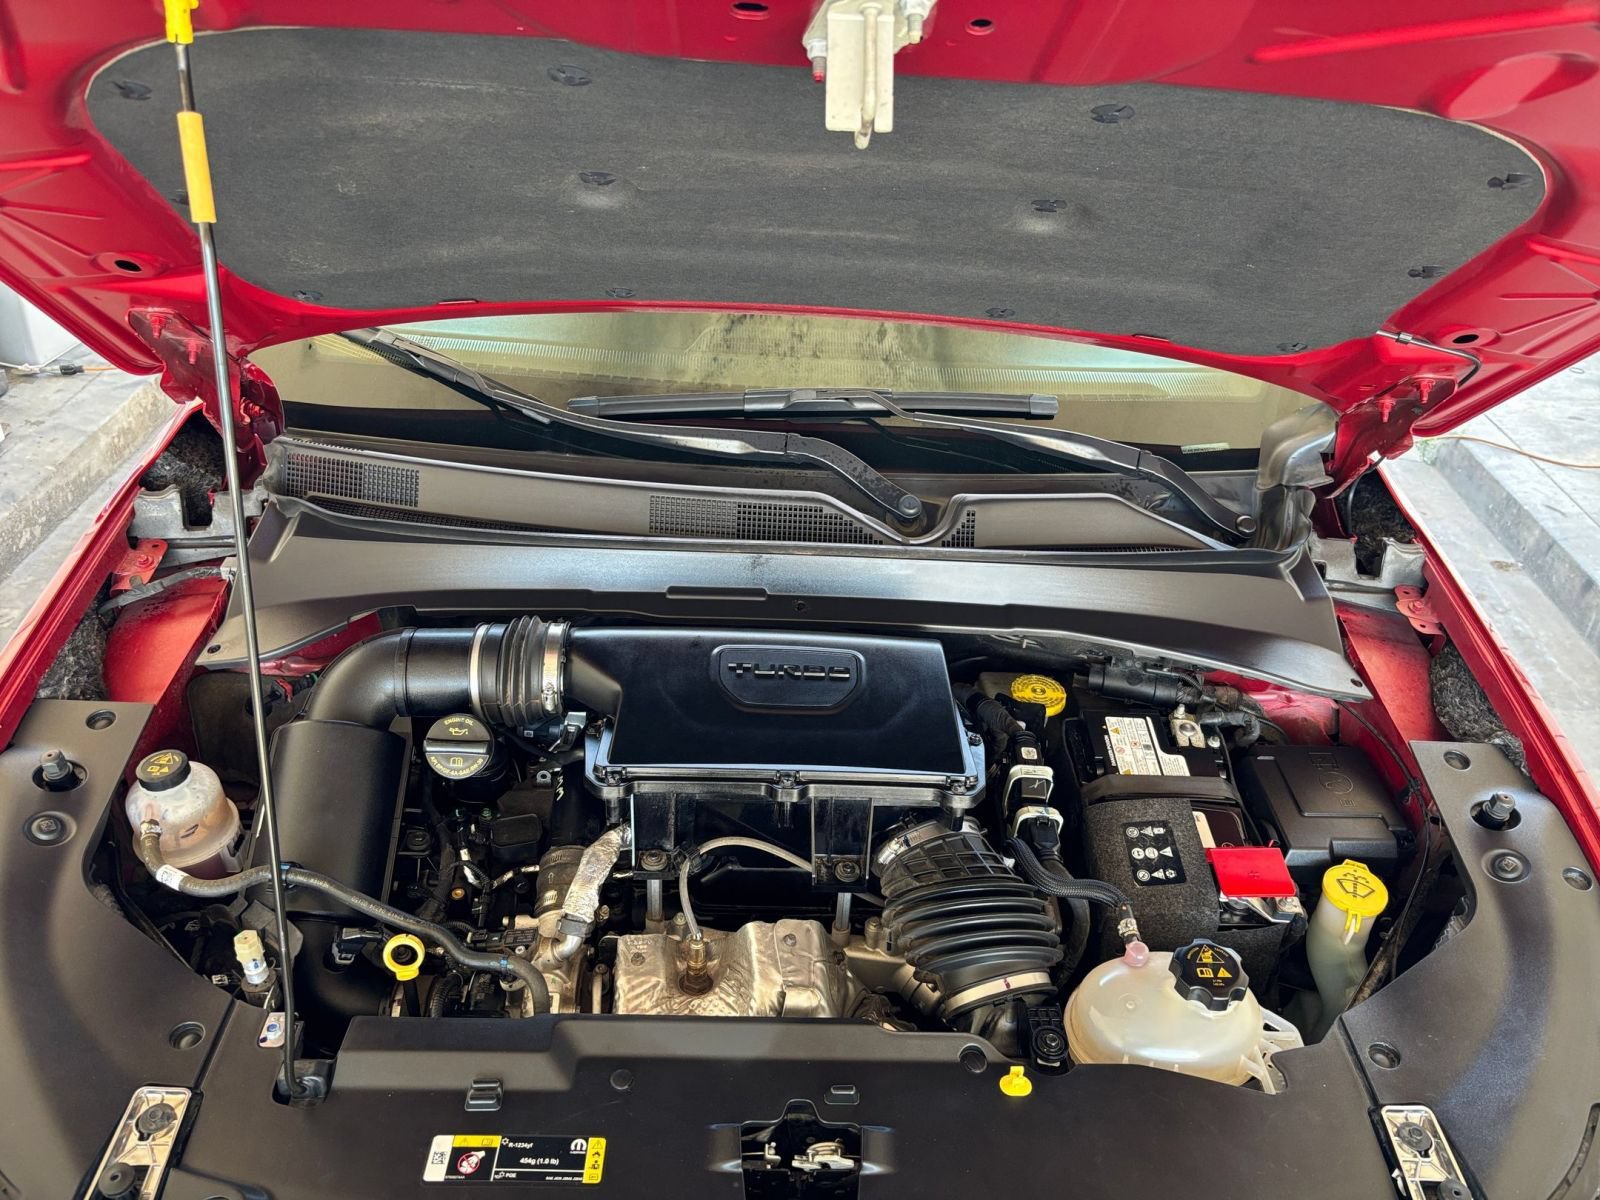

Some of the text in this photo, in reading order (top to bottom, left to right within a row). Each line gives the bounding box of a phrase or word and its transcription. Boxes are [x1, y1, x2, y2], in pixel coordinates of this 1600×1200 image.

[728, 663, 850, 680] TURBO
[519, 1157, 536, 1165] 454g
[550, 1157, 560, 1166] lb)
